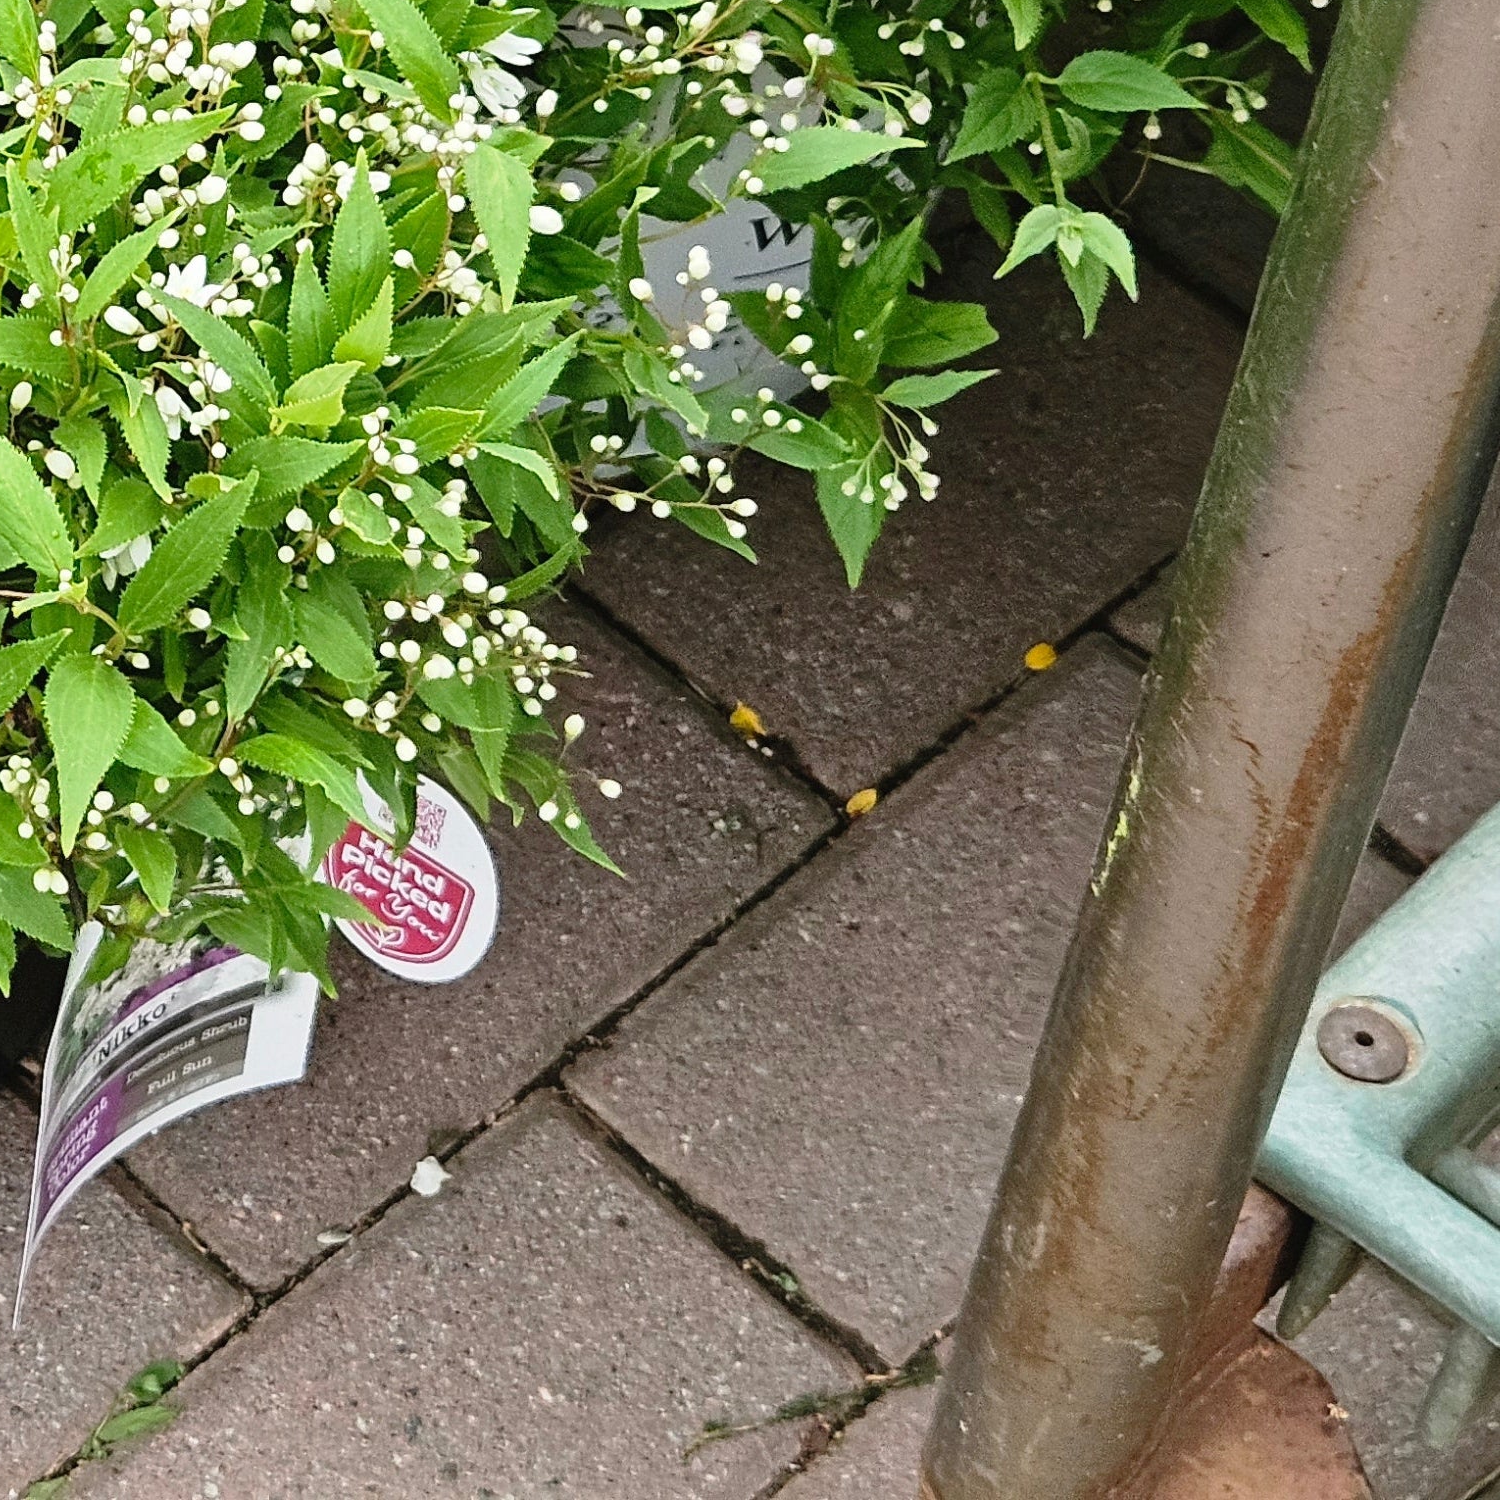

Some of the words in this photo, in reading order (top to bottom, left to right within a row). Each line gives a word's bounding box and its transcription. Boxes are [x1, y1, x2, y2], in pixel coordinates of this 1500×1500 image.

[341, 843, 451, 924] Picked
[380, 892, 444, 942] You
[201, 1016, 248, 1041] Shrub
[147, 1070, 176, 1095] Full
[182, 1055, 212, 1076] Sun
